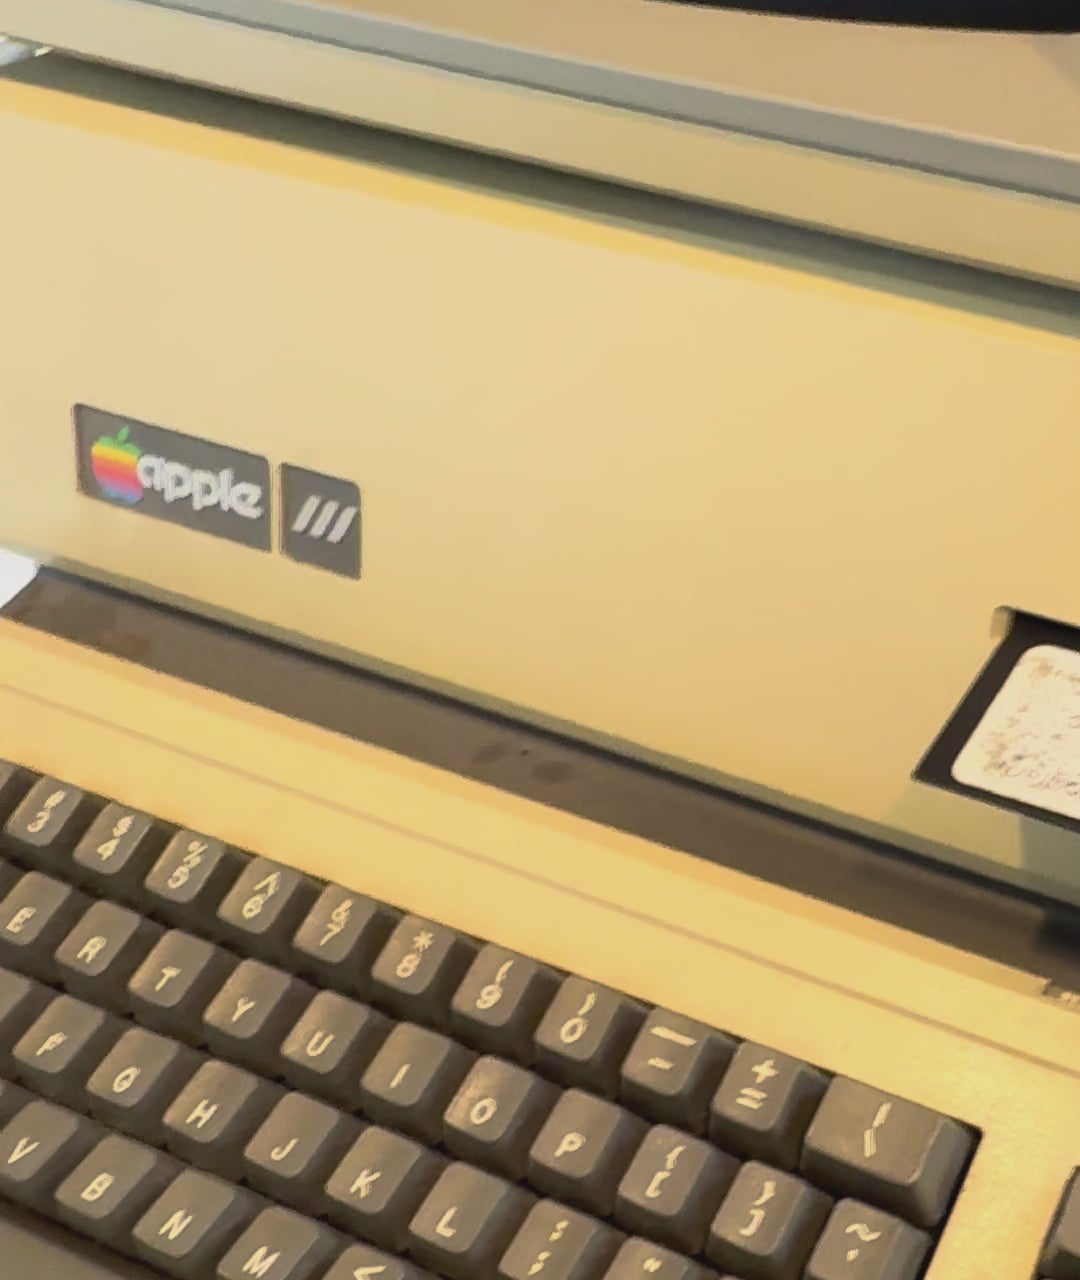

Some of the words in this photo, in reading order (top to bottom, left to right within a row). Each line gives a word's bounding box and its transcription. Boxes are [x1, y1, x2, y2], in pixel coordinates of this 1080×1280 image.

[136, 454, 264, 519] apple
[155, 965, 183, 992] T
[395, 953, 422, 980] 8
[231, 996, 257, 1022] Y
[475, 984, 503, 1012] 9
[35, 1030, 69, 1057] F
[306, 1030, 335, 1058] U
[185, 1098, 219, 1129] H
[469, 1097, 498, 1126] O
[7, 1135, 41, 1166] V
[270, 1137, 299, 1163] J
[554, 1131, 587, 1158] P
[80, 1172, 115, 1202] B
[348, 1167, 382, 1200] K
[157, 1208, 193, 1241] N
[434, 1206, 457, 1238] L
[241, 1245, 281, 1279] M
